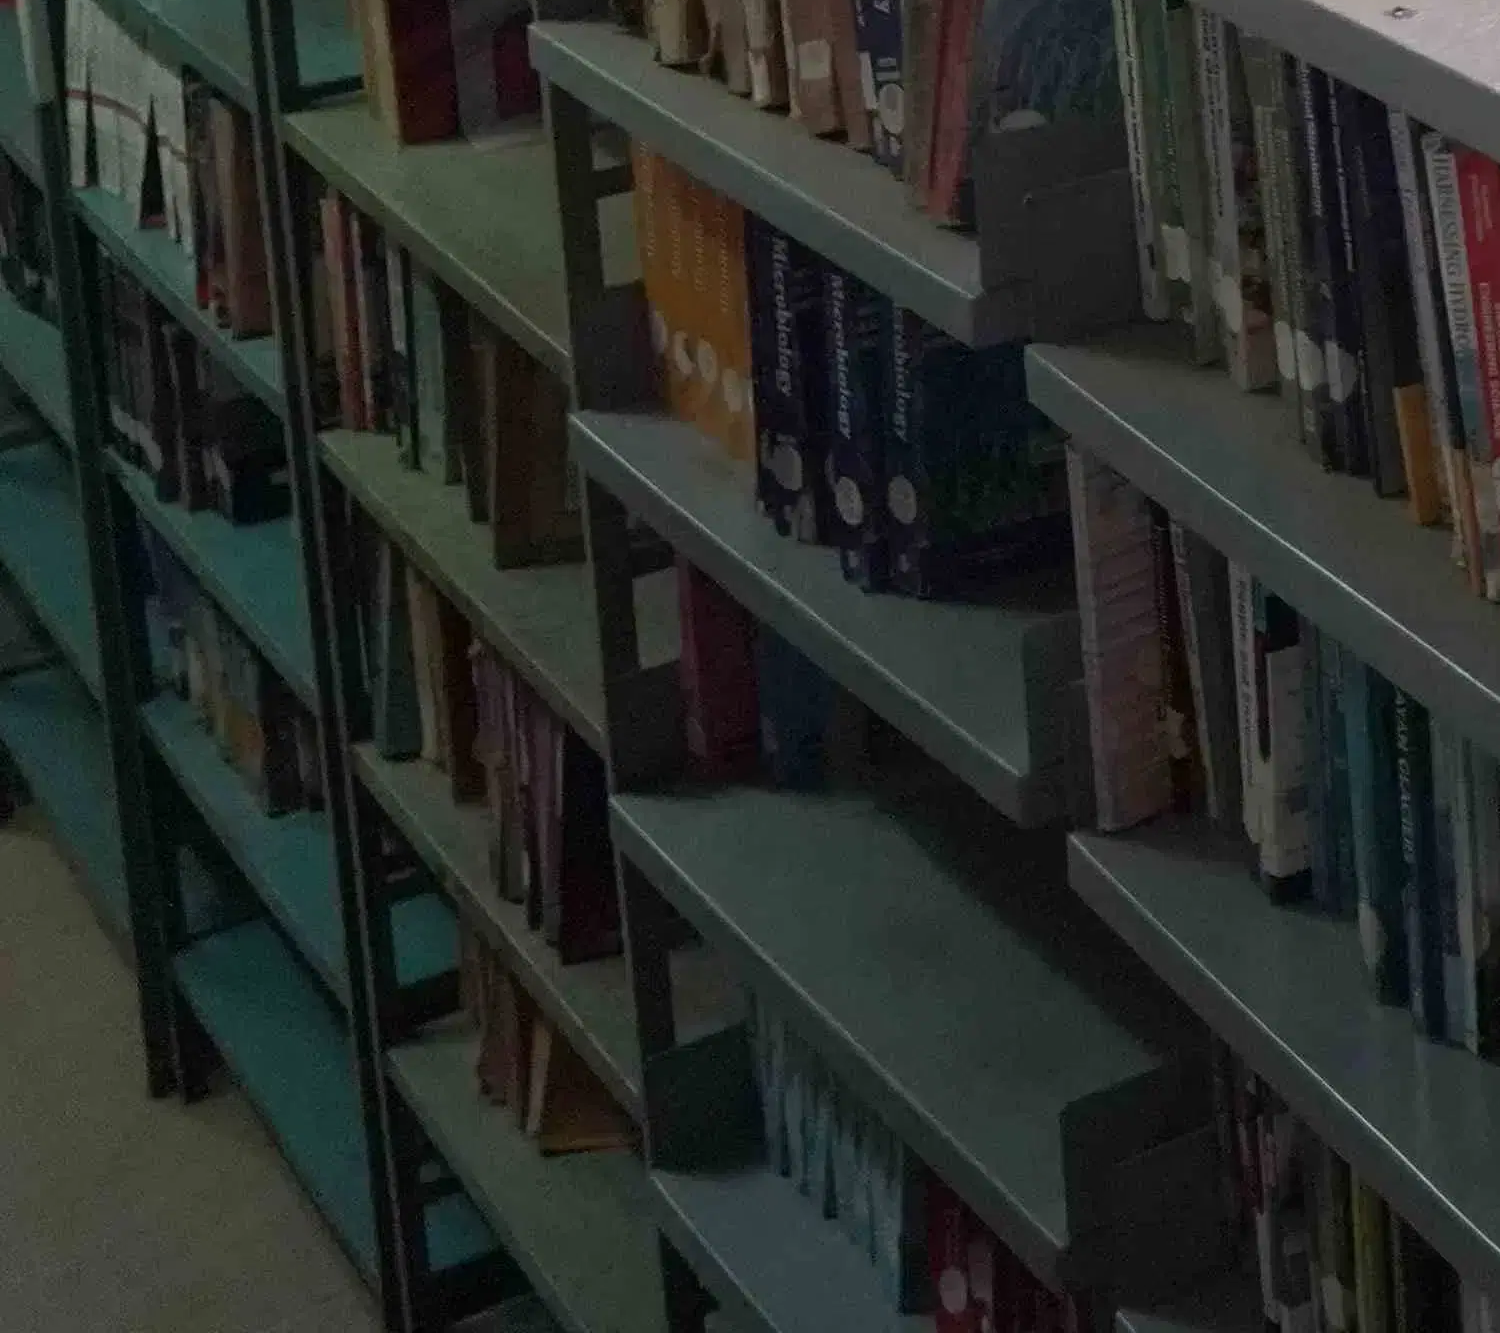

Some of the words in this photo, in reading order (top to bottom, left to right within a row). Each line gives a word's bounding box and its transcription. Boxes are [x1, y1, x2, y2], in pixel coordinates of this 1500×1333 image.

[1432, 157, 1464, 277] HARNESSING
[769, 237, 796, 398] Microbiology
[830, 274, 854, 442] Microbiology
